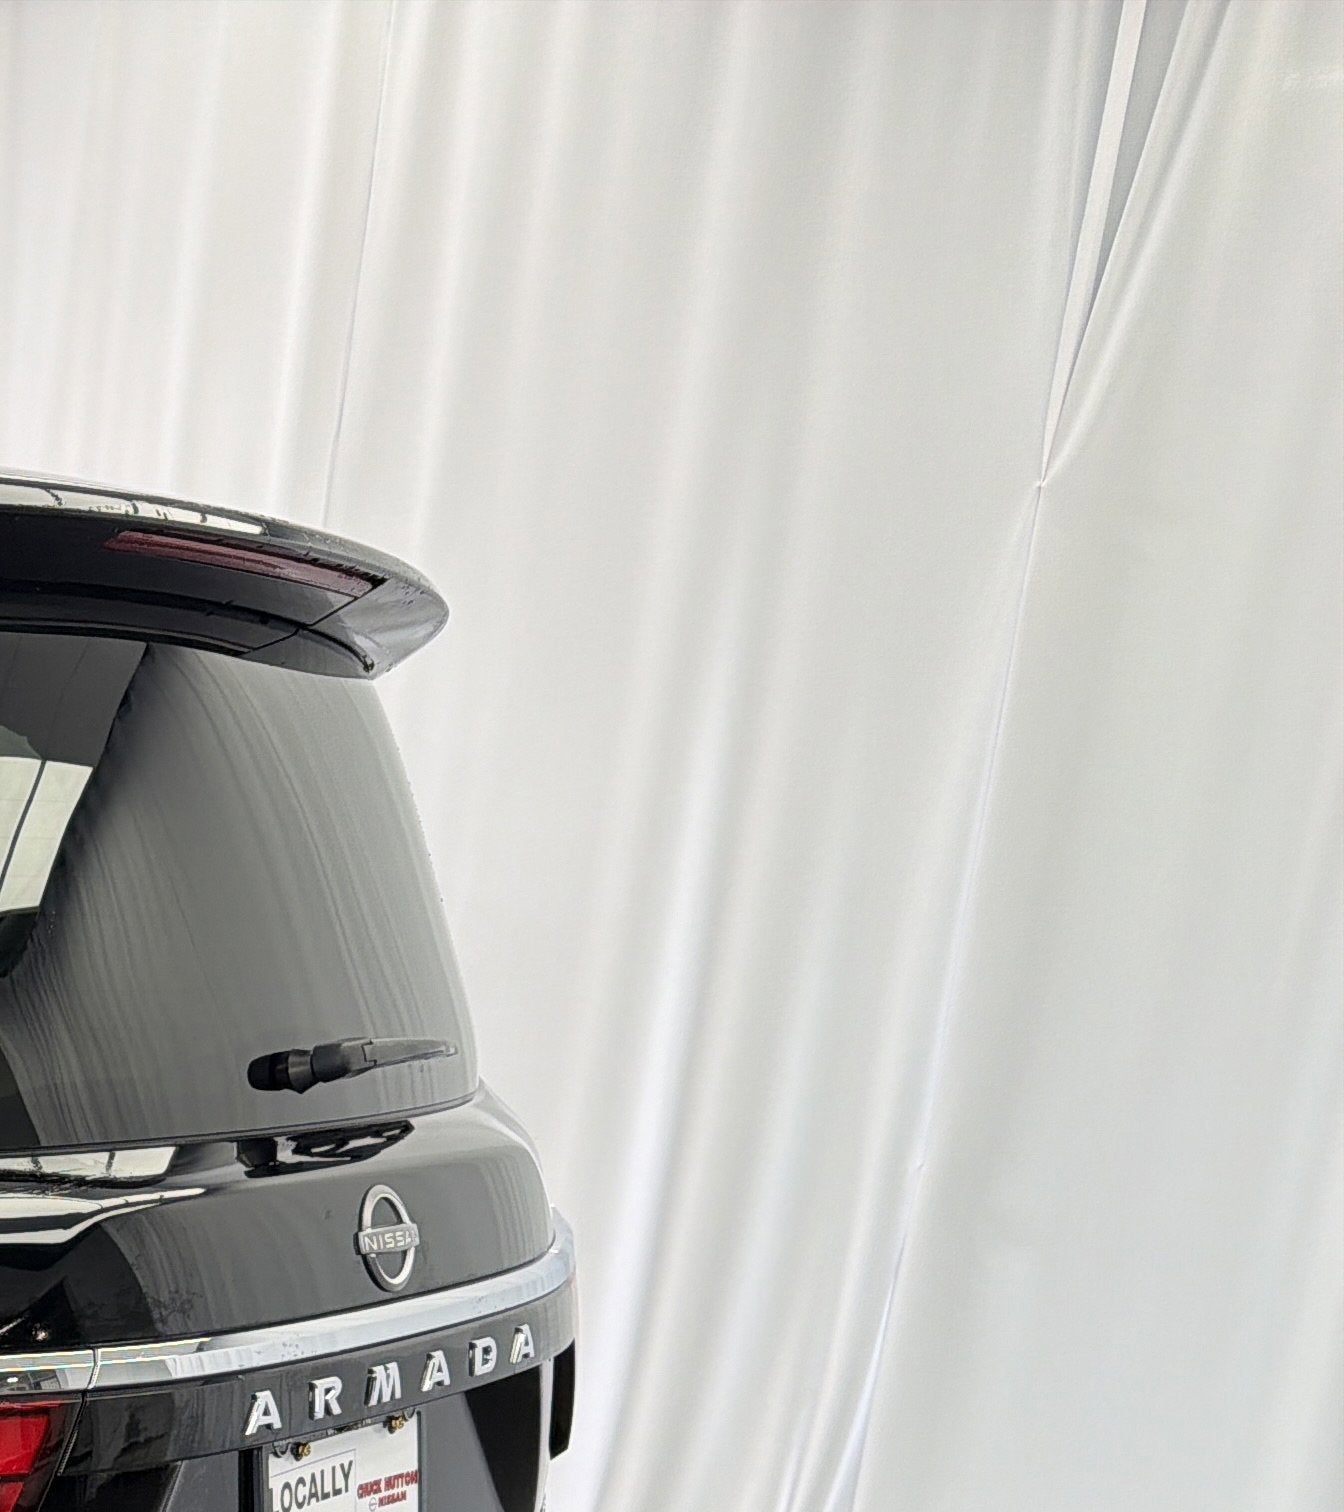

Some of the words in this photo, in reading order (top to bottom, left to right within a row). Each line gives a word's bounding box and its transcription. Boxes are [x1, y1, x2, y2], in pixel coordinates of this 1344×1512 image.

[244, 1323, 535, 1437] ARMADA
[357, 1478, 382, 1500] CHUCK
[384, 1469, 419, 1492] HUTTON
[378, 1490, 407, 1508] NISSAN
